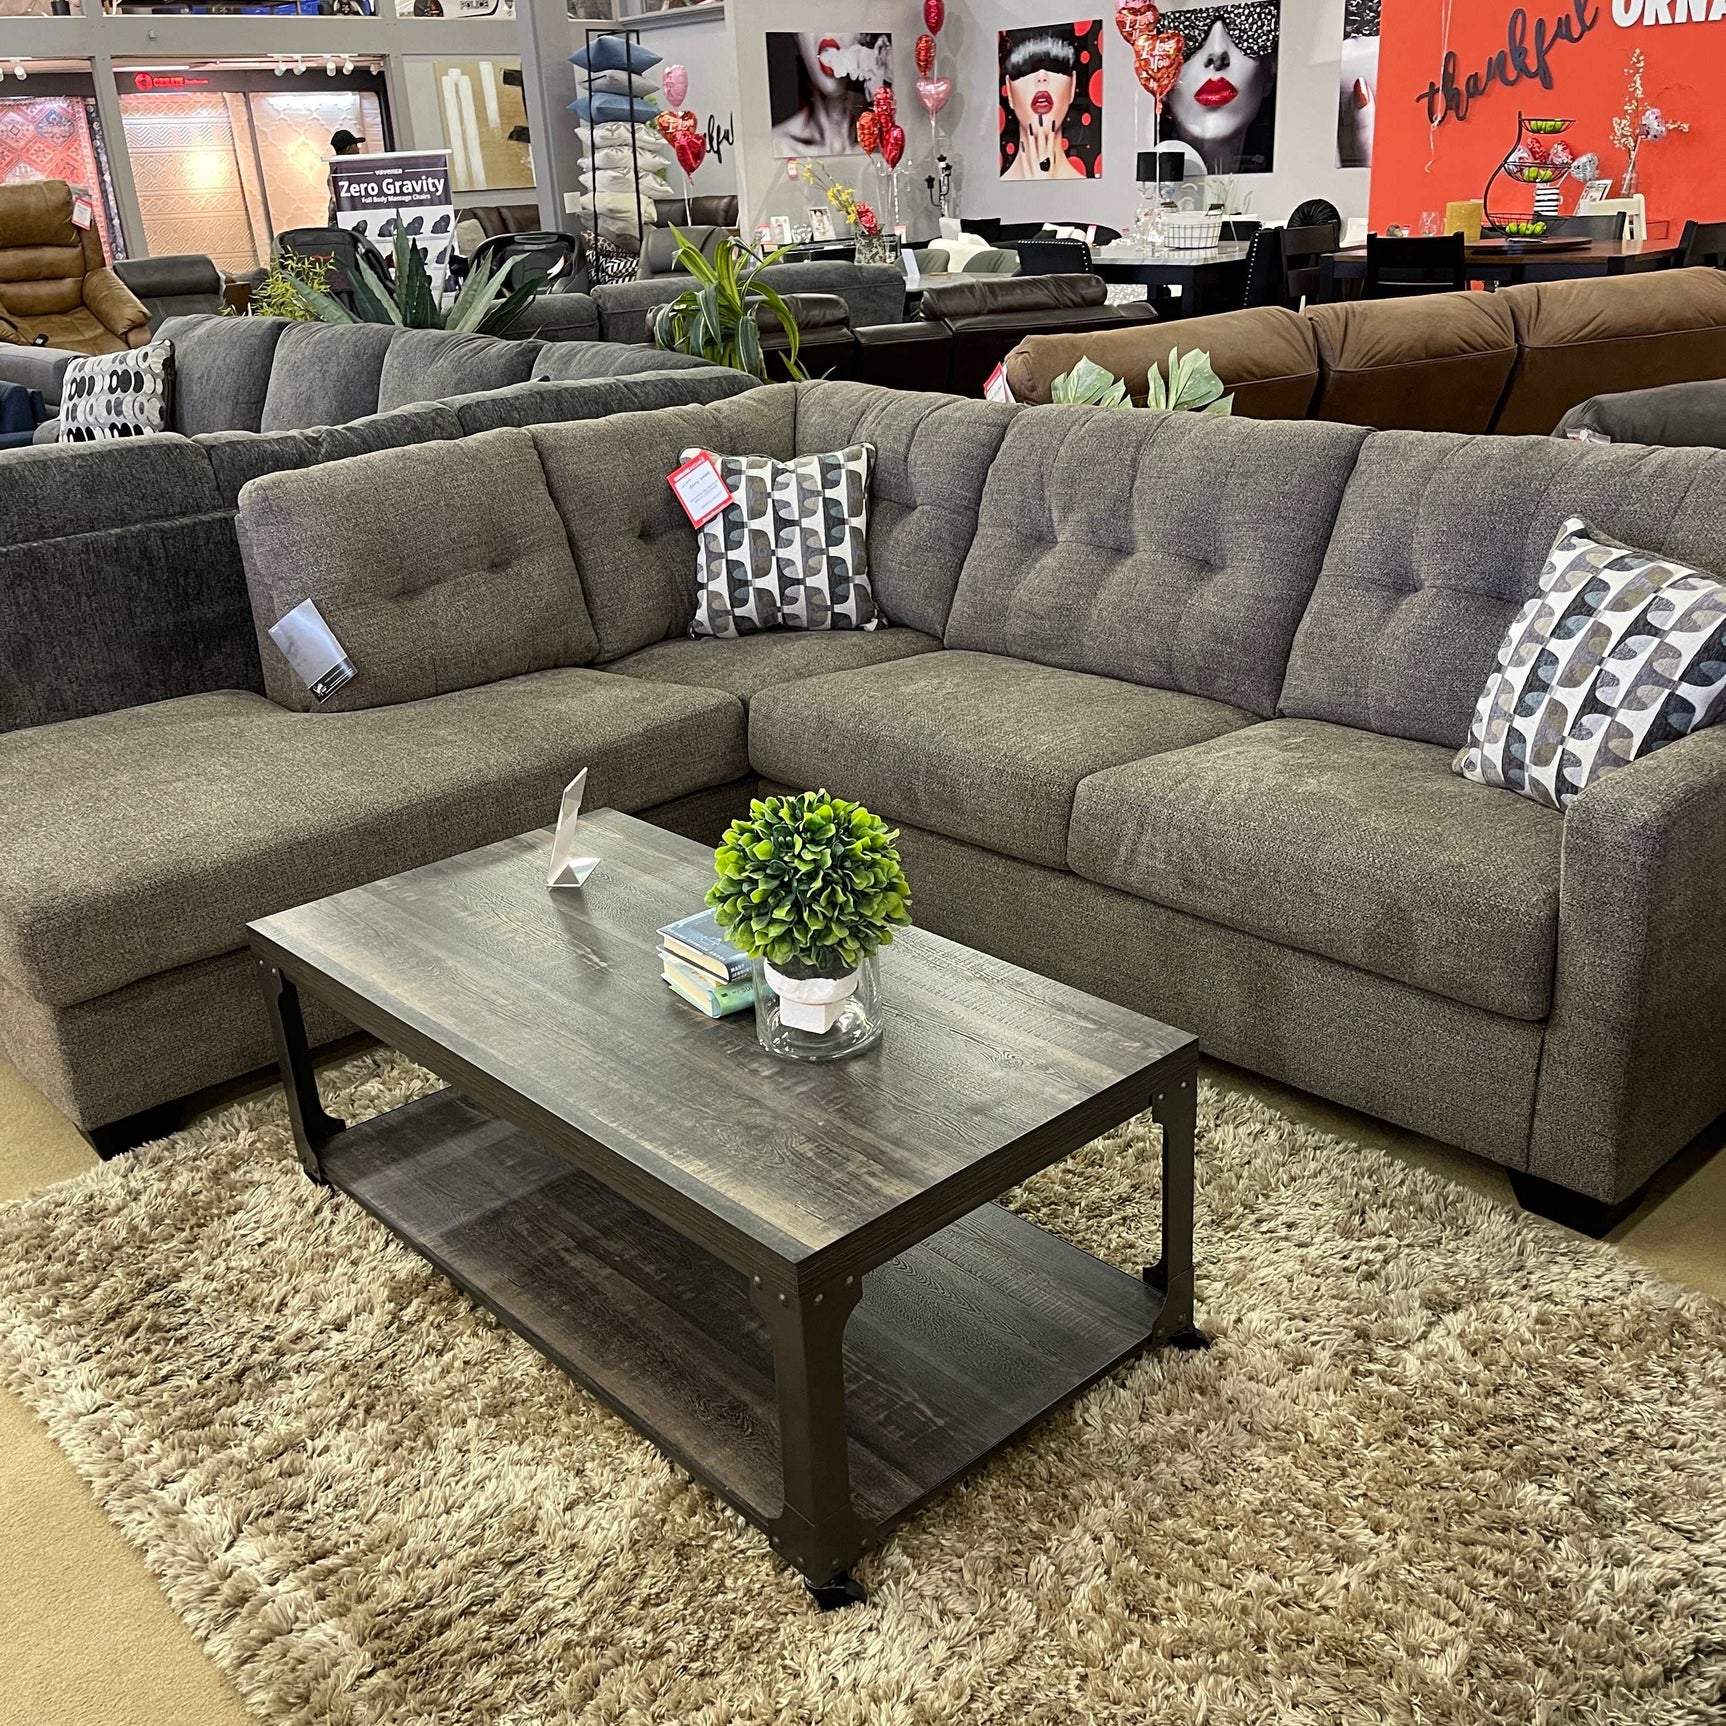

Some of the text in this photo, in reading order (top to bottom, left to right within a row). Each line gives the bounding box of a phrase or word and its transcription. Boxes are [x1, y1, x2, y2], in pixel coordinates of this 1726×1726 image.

[1416, 0, 1599, 126] thankful
[338, 175, 445, 197] Zero Gravity
[373, 196, 387, 204] Body
